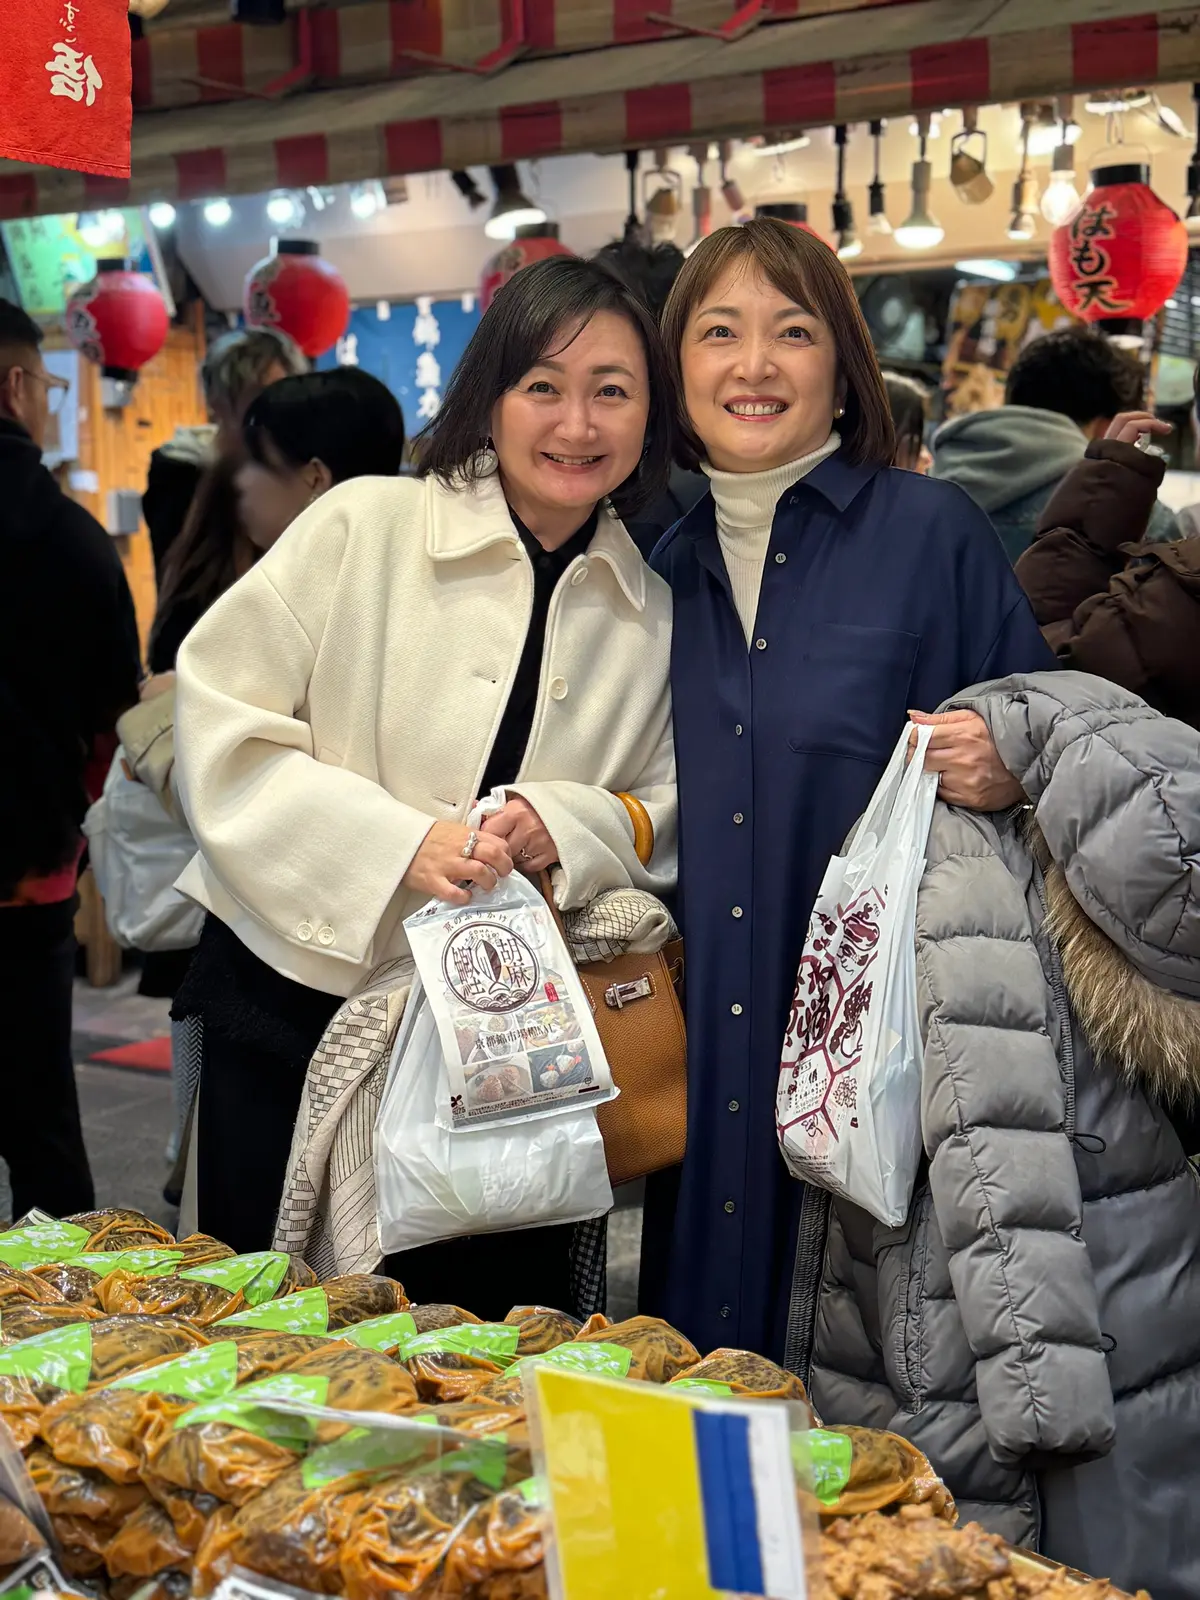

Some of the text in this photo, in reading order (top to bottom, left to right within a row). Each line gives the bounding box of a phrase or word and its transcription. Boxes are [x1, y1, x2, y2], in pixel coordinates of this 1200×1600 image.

[1069, 202, 1133, 312] はも天
[442, 910, 508, 934] 京のふりかけ
[498, 937, 532, 988] 胡麻
